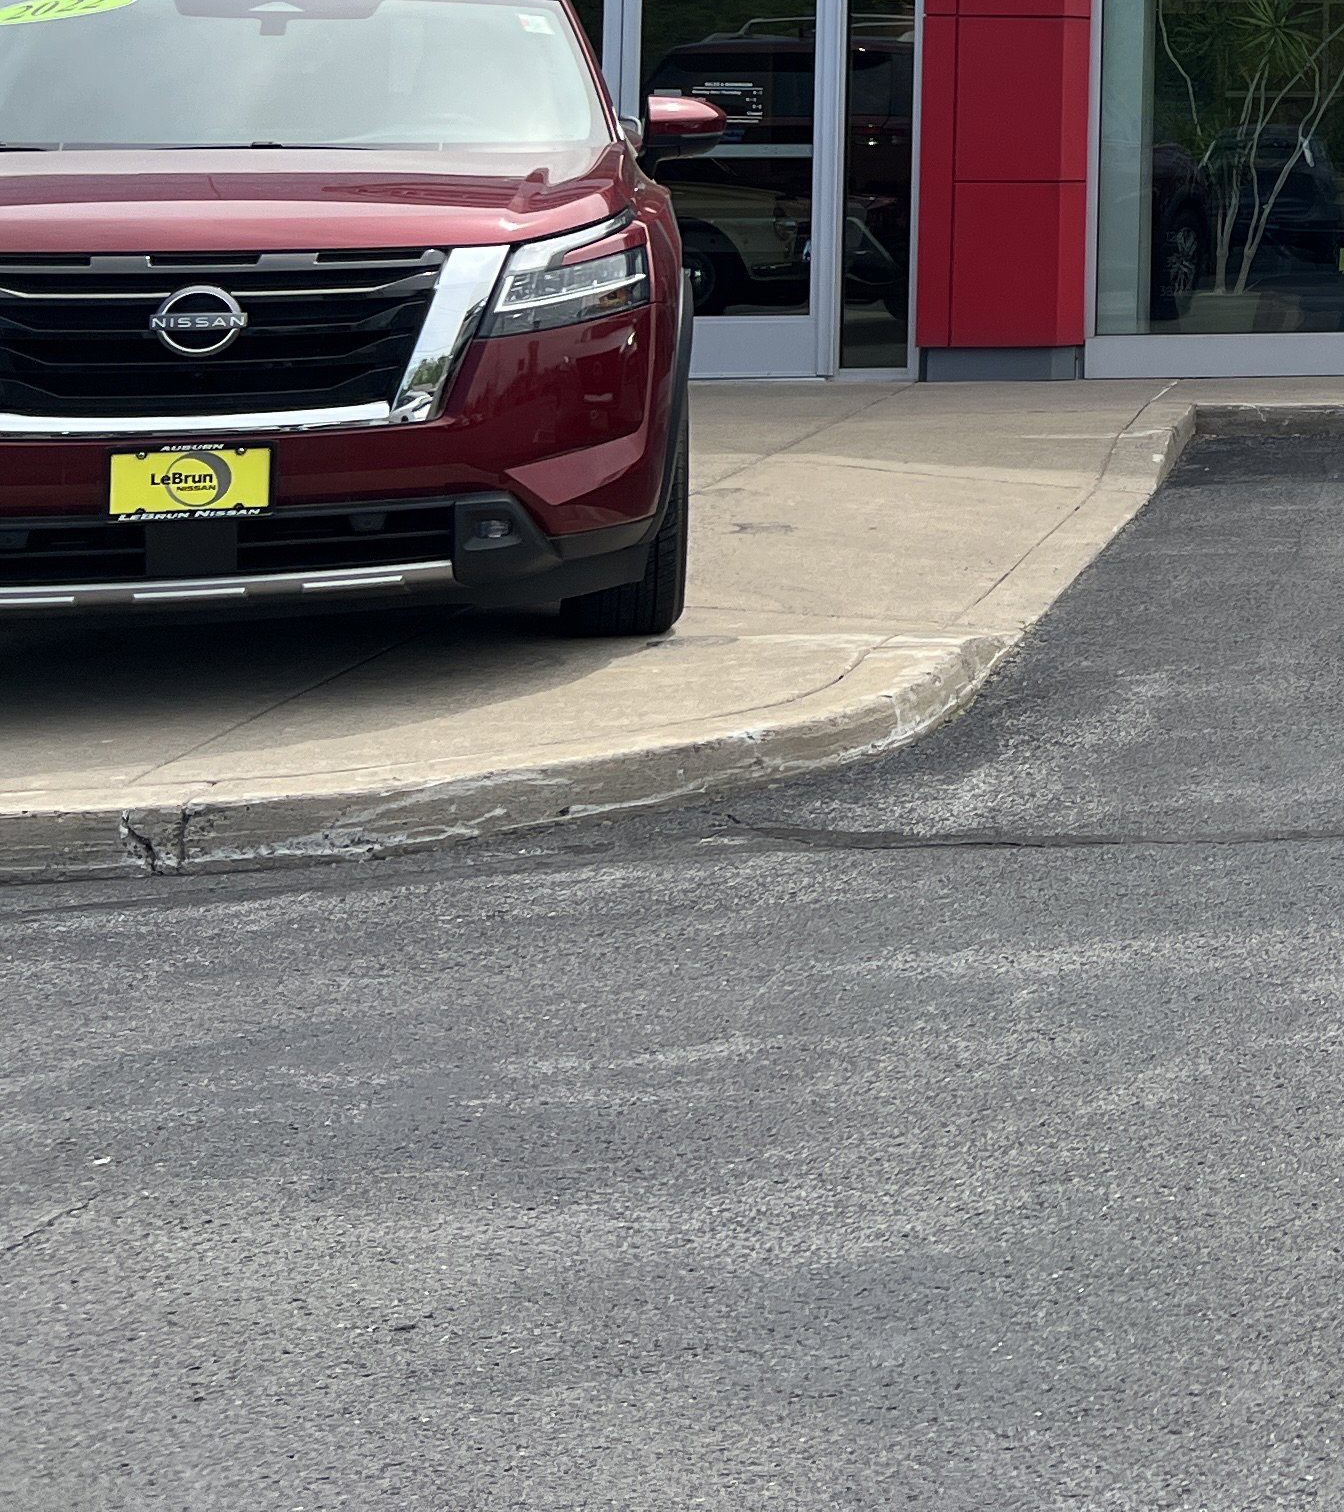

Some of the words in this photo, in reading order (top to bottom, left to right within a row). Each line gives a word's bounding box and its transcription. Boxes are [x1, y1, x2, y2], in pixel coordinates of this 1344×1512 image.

[151, 316, 245, 328] NISSAN
[160, 443, 225, 452] AUBURN
[150, 472, 214, 486] LeBrun
[176, 484, 217, 492] NISSAN
[194, 508, 261, 518] NISSAN
